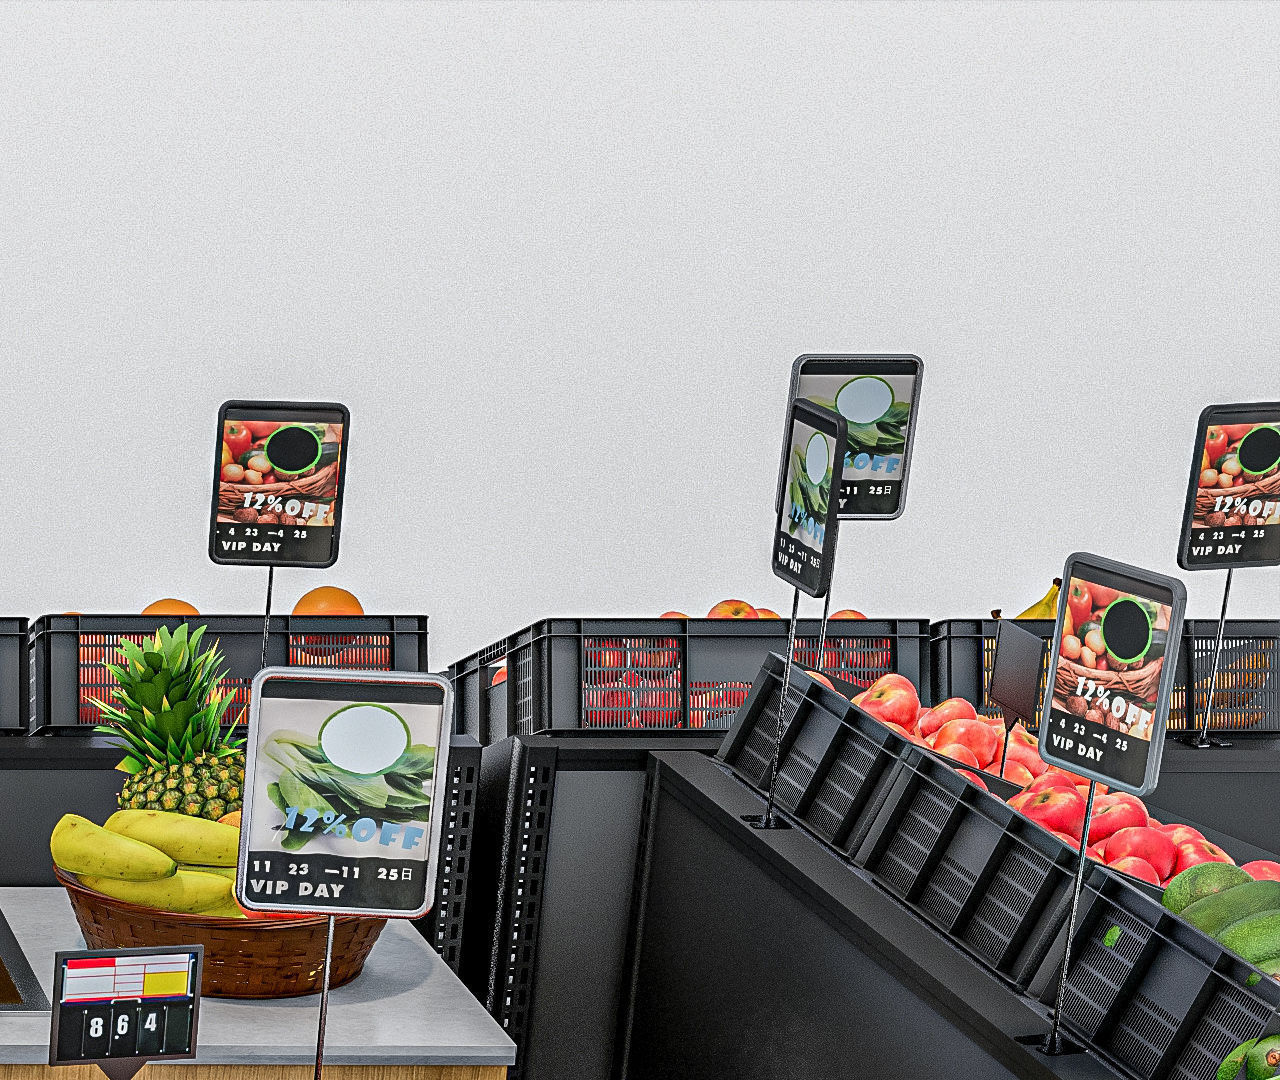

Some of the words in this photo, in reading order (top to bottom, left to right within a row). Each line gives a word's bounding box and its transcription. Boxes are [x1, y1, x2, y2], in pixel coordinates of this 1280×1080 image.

[245, 528, 258, 536] 23
[222, 541, 246, 550] VIP
[252, 542, 281, 552] DAY
[1192, 546, 1212, 555] VIP
[1217, 544, 1242, 554] DAY
[778, 552, 788, 565] VIP
[790, 559, 802, 573] DAY
[1060, 719, 1065, 728] 4
[1074, 723, 1086, 735] 23
[1115, 738, 1128, 751] 25
[1052, 734, 1073, 750] VIP
[1078, 743, 1103, 761] DAY
[253, 861, 271, 872] 11
[289, 864, 309, 875] 23
[250, 879, 289, 895] VIP
[299, 882, 344, 898] DAY
